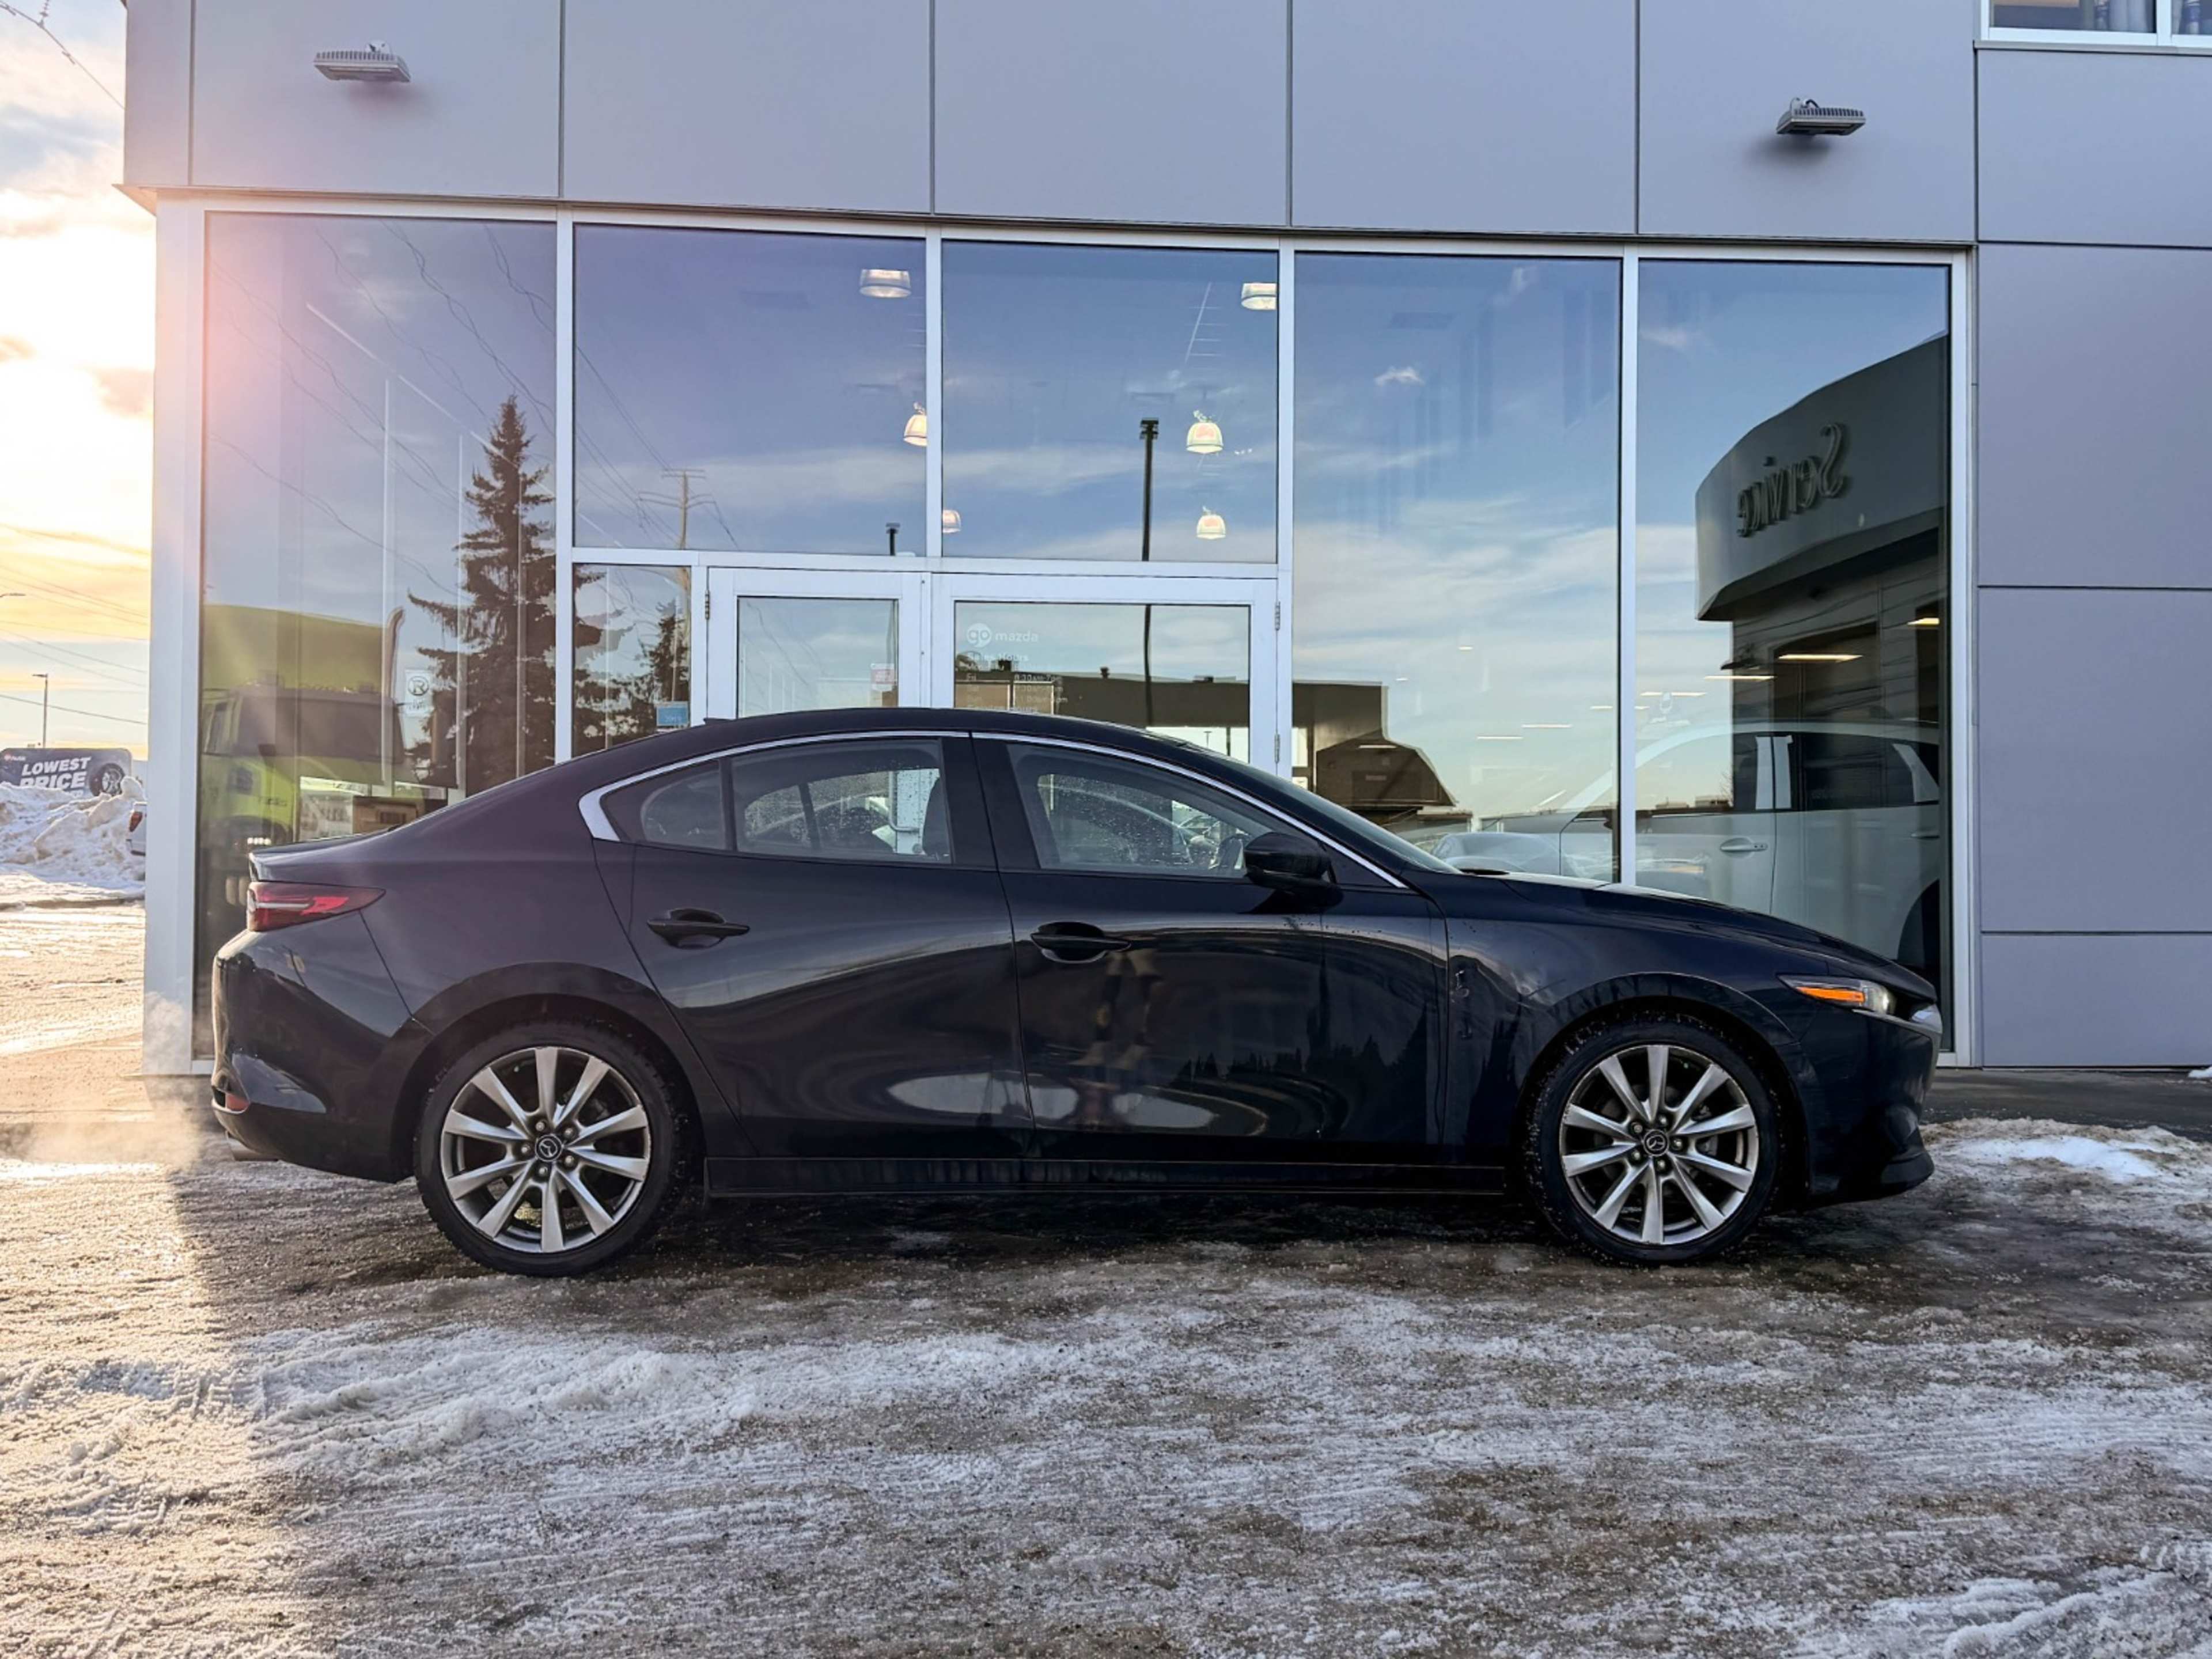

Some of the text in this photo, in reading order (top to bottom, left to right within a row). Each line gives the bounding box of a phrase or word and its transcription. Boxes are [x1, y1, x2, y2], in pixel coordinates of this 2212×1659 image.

[995, 630, 1039, 642] mazda
[21, 756, 92, 777] LOWEST
[20, 771, 87, 789] PRICE
